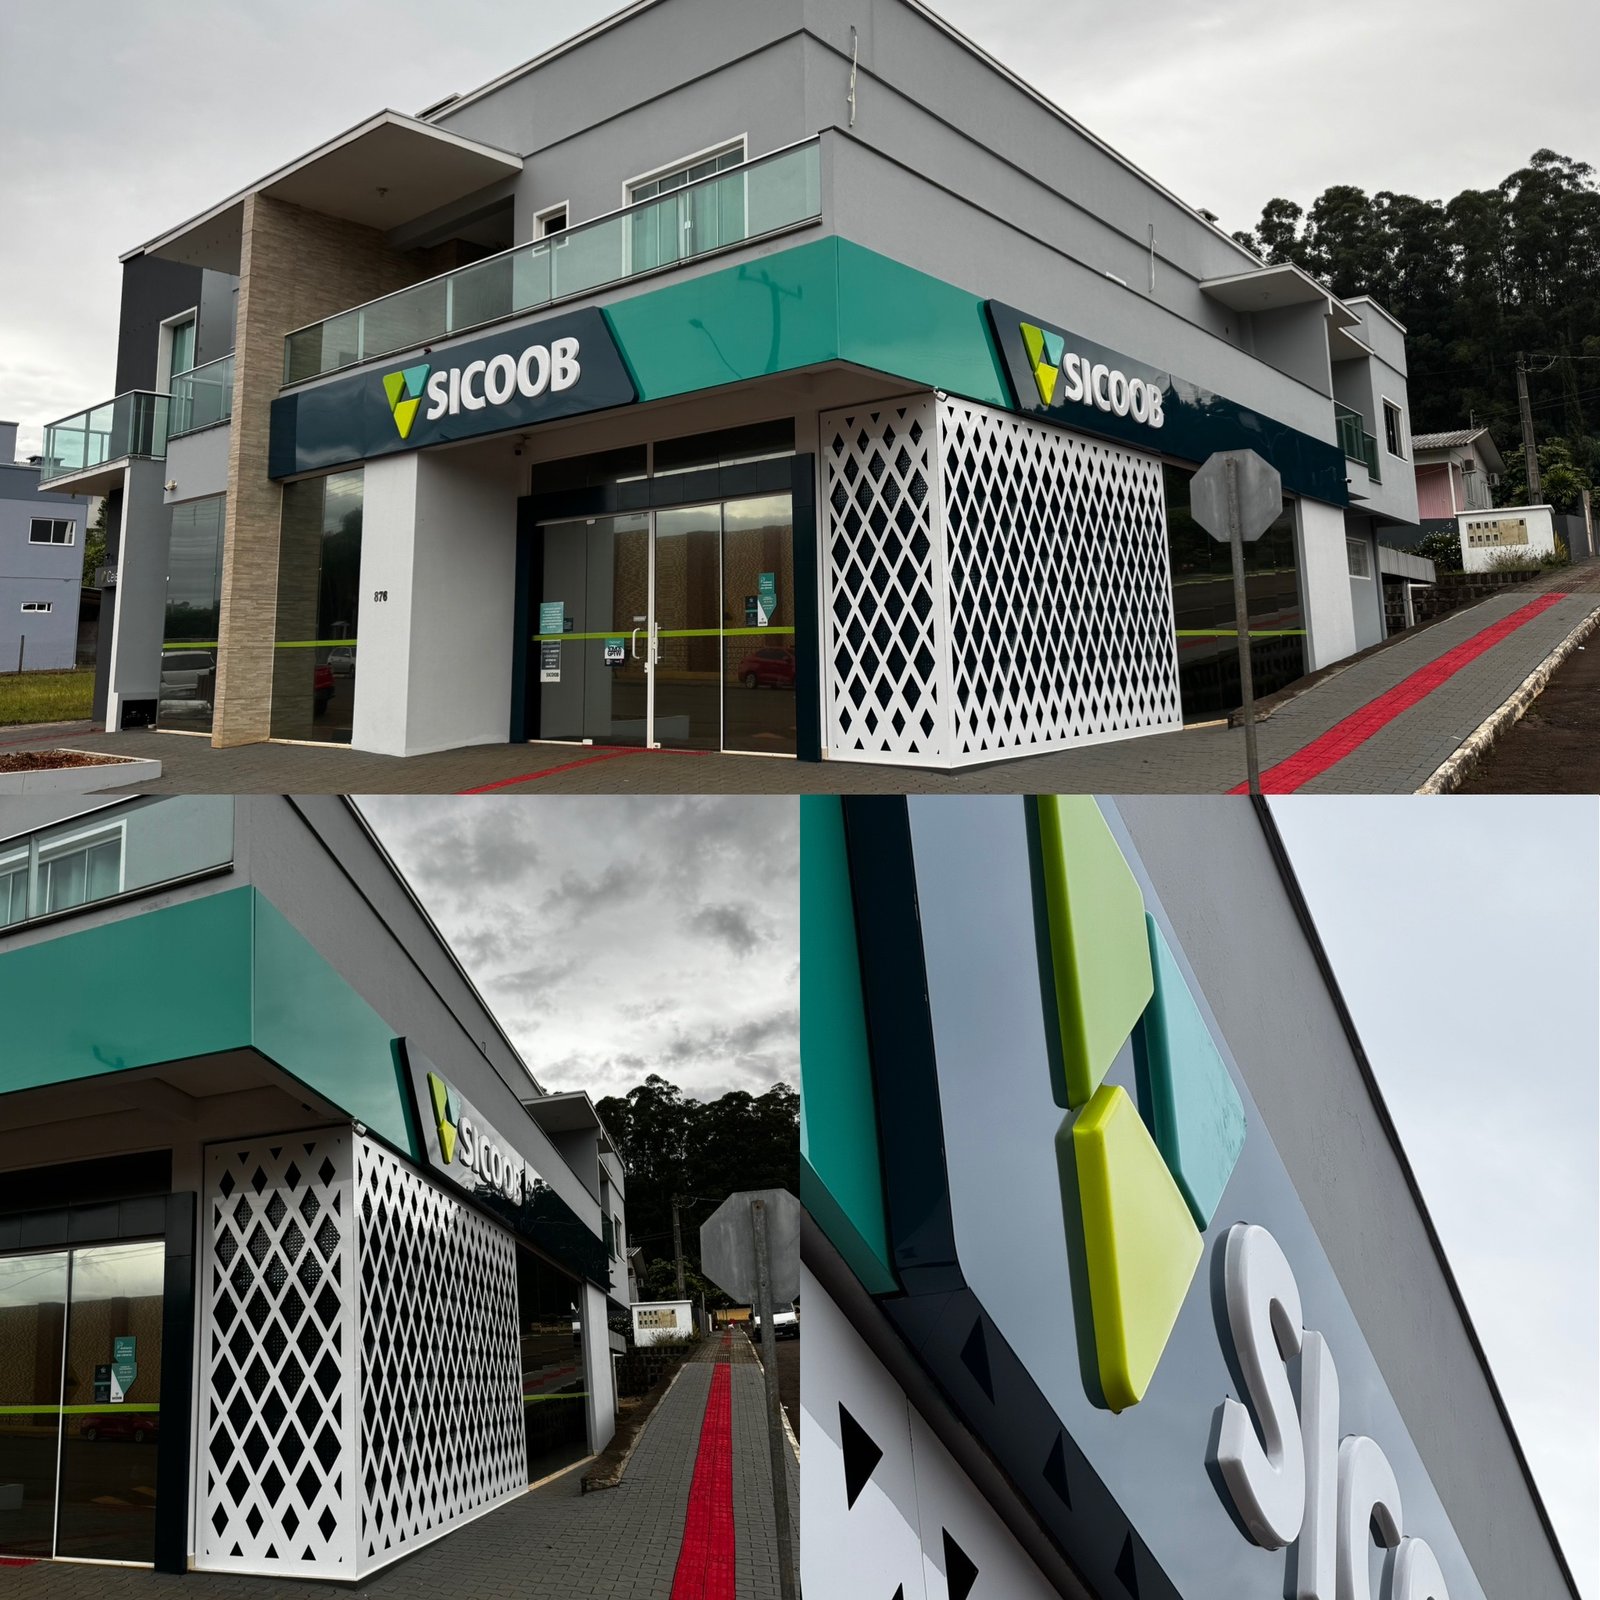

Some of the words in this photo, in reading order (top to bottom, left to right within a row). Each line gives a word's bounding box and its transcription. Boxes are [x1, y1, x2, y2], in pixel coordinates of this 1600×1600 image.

[426, 337, 581, 421] SICOOB
[1062, 352, 1164, 429] SICOOB
[458, 1116, 523, 1207] SICOOB
[1204, 1221, 1449, 1600] SIC
